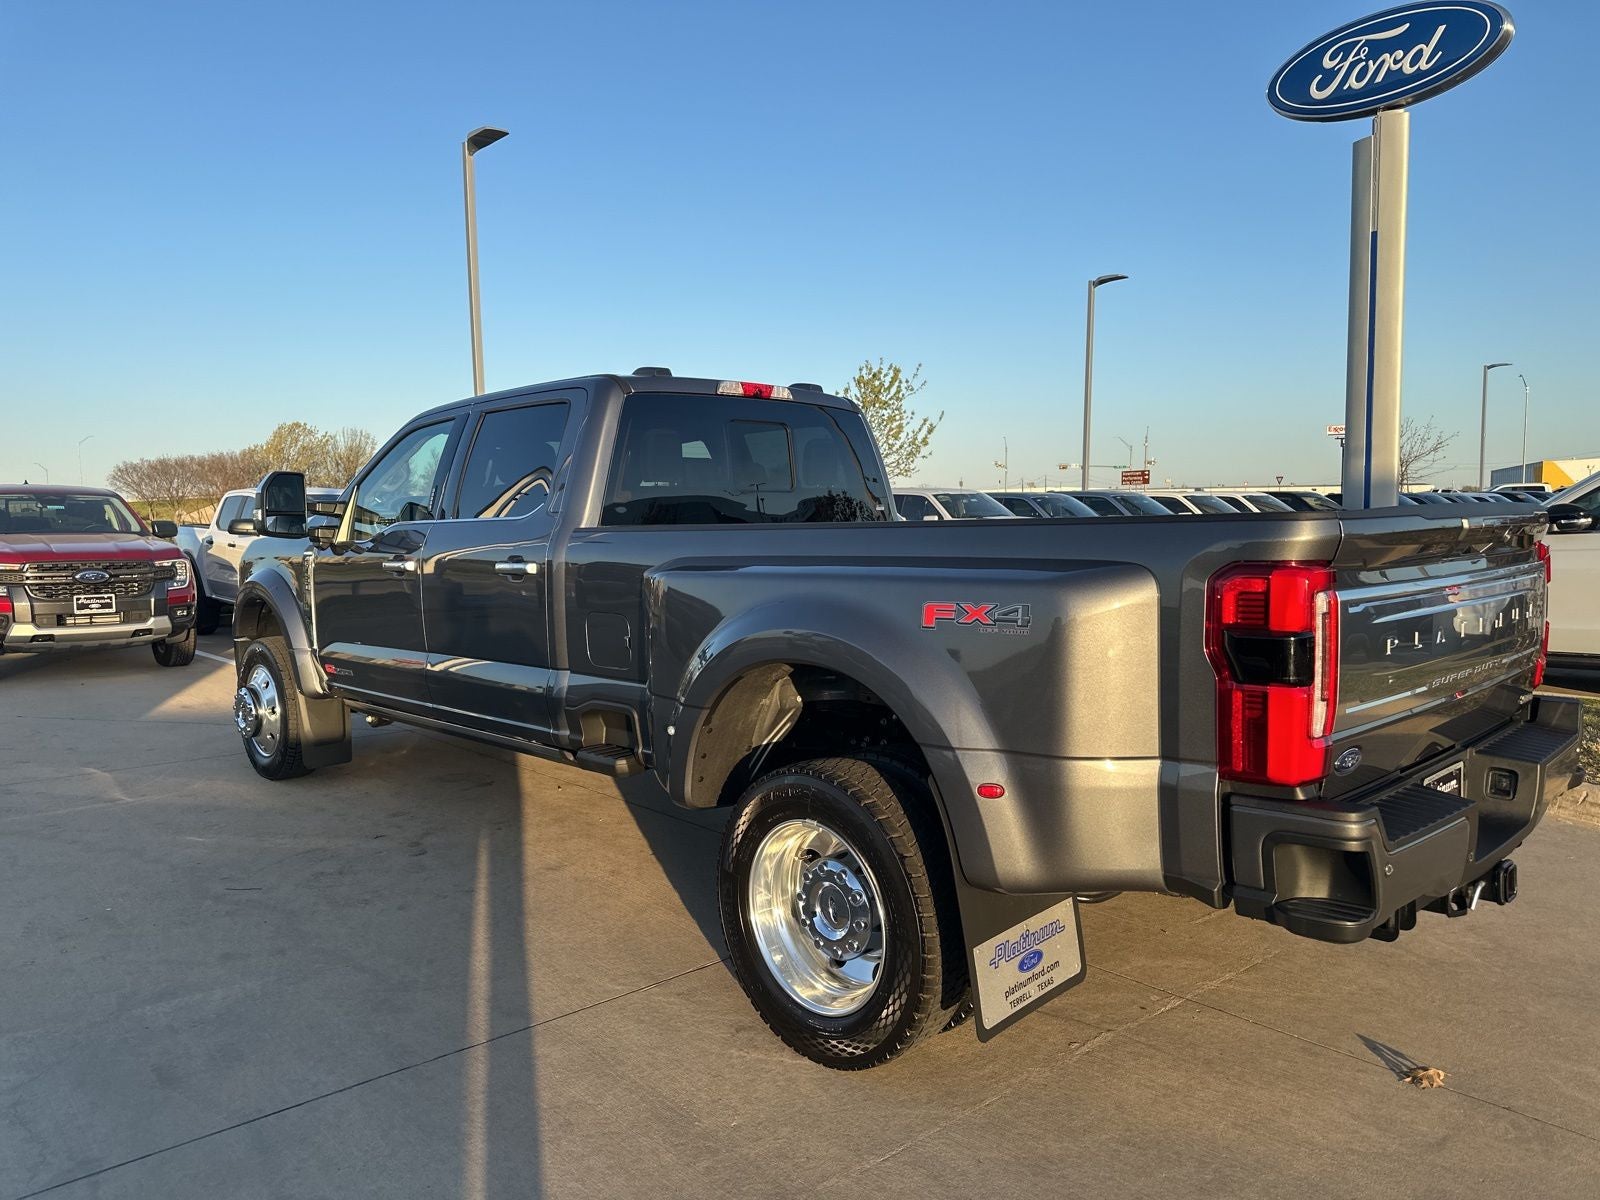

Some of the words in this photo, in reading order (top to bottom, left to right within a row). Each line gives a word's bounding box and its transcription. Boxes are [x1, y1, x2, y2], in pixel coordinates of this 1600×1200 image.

[1309, 22, 1446, 100] Ford
[922, 601, 1031, 630] FX4
[989, 919, 1065, 969] Platinum
[1022, 953, 1039, 970] Ford
[1004, 960, 1060, 1001] platinumford.com
[1009, 990, 1032, 1009] TERRELL
[1037, 976, 1055, 992] TEXAS
